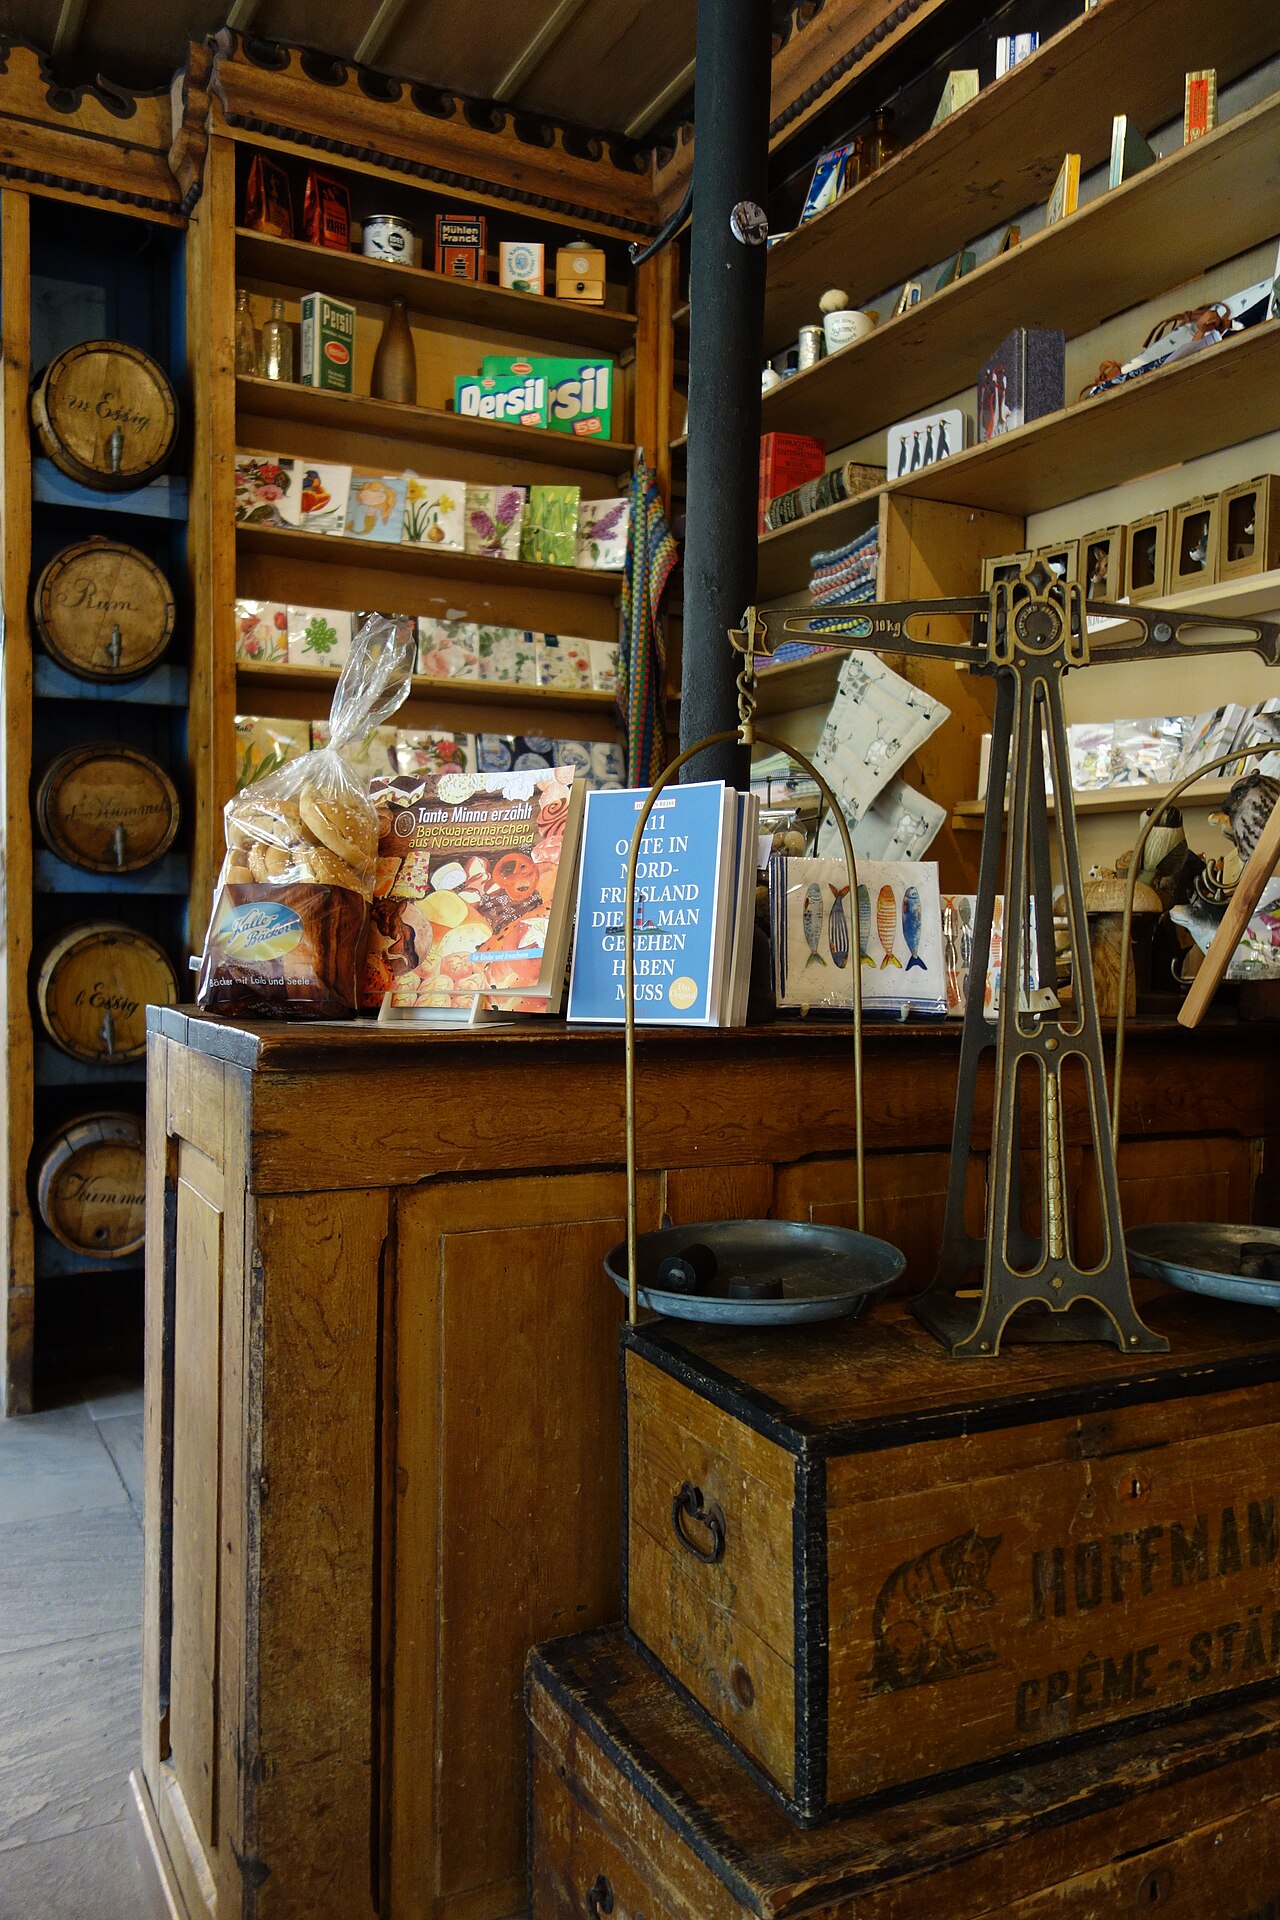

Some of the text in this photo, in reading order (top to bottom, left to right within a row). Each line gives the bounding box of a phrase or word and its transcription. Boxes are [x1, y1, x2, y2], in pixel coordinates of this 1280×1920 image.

[442, 225, 479, 235] Mühlen
[442, 234, 479, 243] Franck
[323, 303, 352, 336] Persil
[96, 392, 150, 434] Essig
[521, 413, 540, 425] 59
[575, 418, 600, 433] 59
[57, 578, 138, 612] Rum
[873, 619, 901, 638] 10kg
[418, 802, 533, 823] Tante Minna erzählt
[416, 823, 530, 838] Backwarenmärchen
[408, 833, 535, 849] aus Norddeutschland
[615, 835, 689, 856] OTE IN
[591, 908, 700, 928] DIE MAN
[244, 924, 290, 948] Bäcker
[601, 933, 687, 952] GEEHEN
[209, 976, 233, 988] Bäcker
[250, 976, 267, 985] Laib
[268, 976, 284, 986] und
[287, 976, 310, 986] Seele
[677, 982, 690, 991] Das
[88, 981, 140, 1018] Essig
[670, 988, 696, 1001] Original
[1030, 1496, 1277, 1623] HOFFMAN
